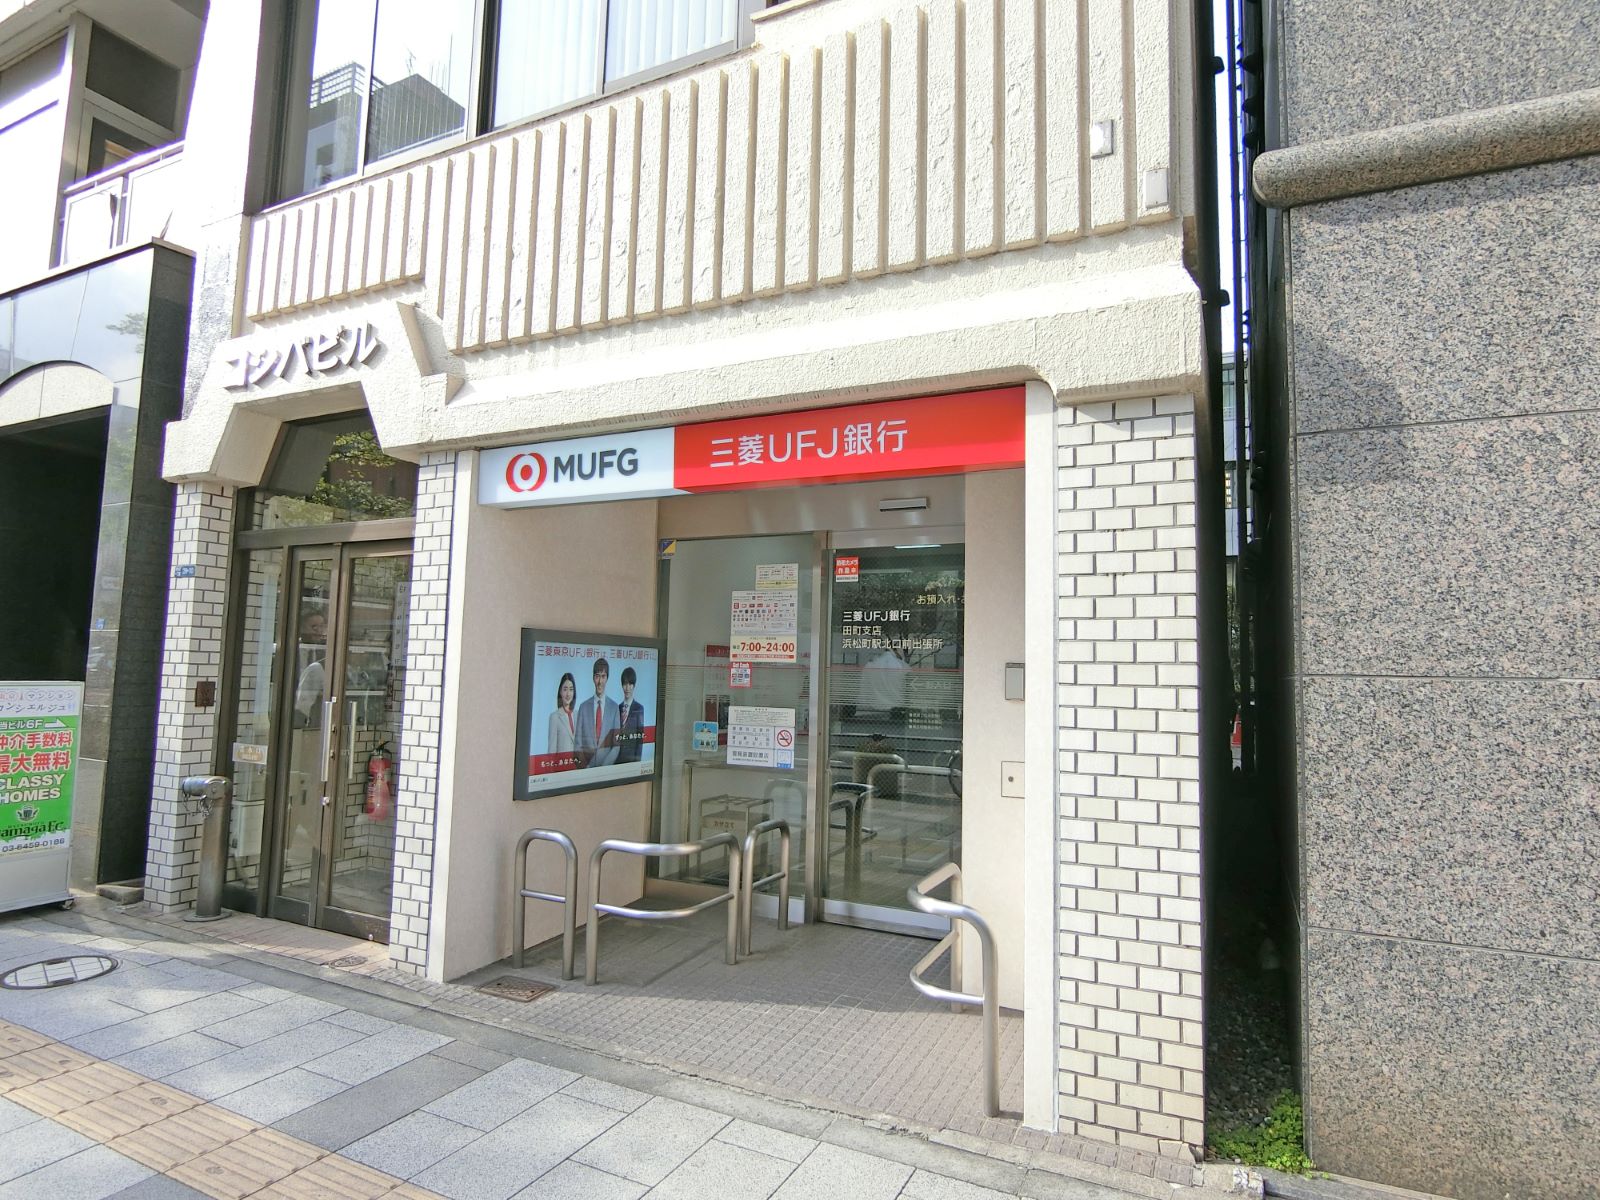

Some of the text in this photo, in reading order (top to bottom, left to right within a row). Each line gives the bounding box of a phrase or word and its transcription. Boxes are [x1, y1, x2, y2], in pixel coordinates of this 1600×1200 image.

[710, 419, 908, 468] 三菱UFJ銀行
[552, 447, 639, 483] MUFG
[842, 609, 911, 622] 三菱UFJ銀行
[842, 625, 882, 636] 田町支店
[842, 638, 944, 649] 浜松町駅北口前出張所
